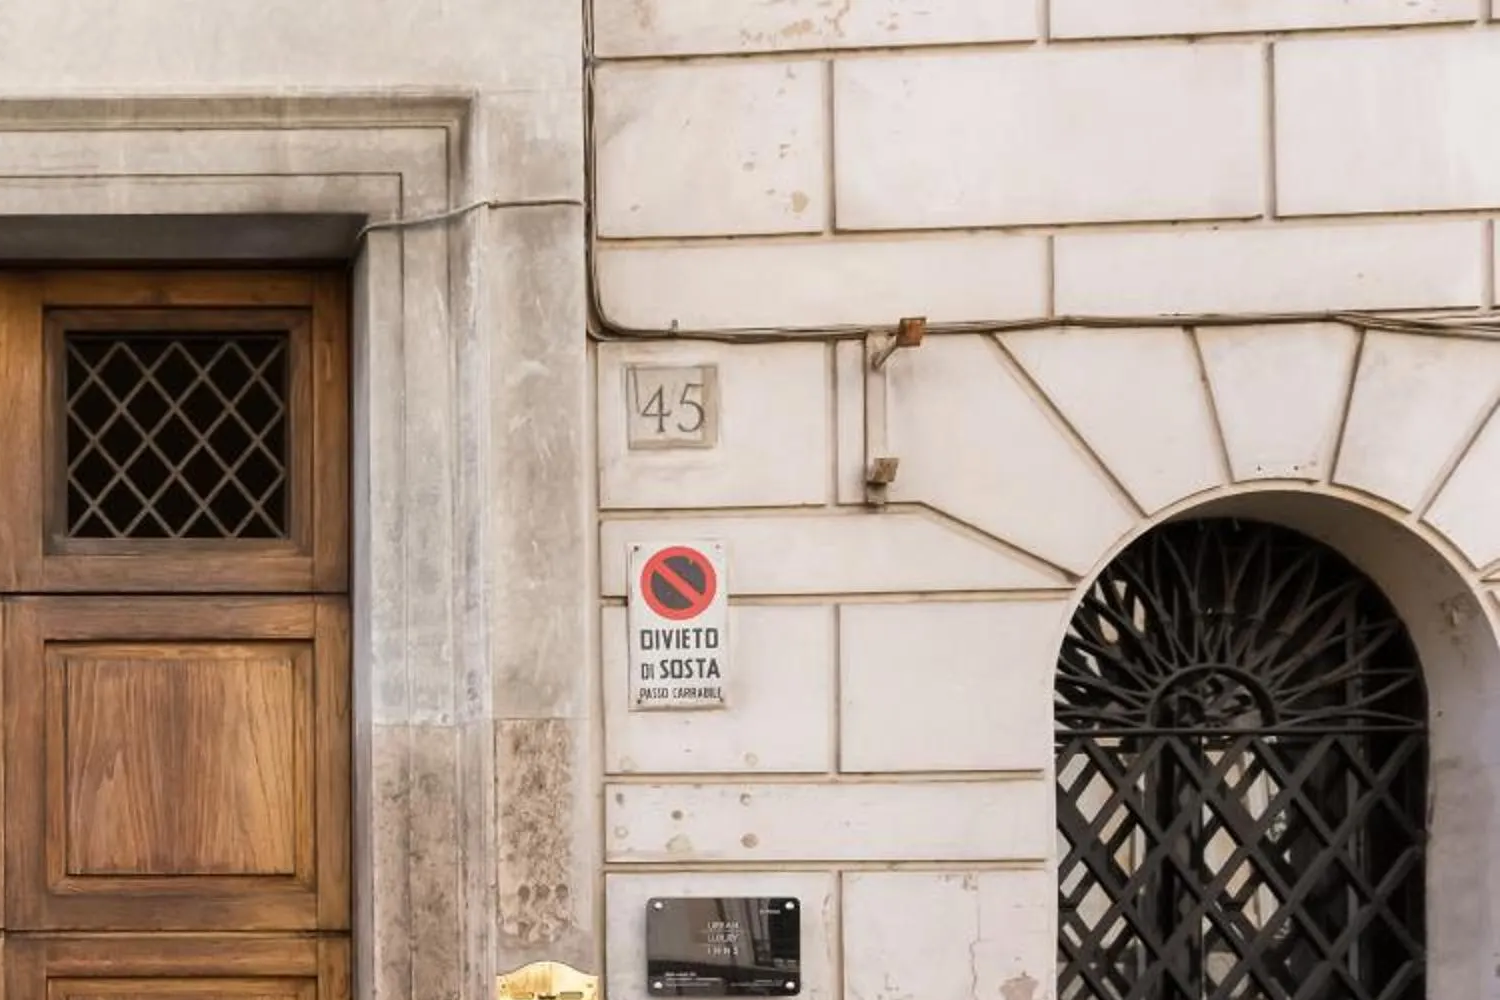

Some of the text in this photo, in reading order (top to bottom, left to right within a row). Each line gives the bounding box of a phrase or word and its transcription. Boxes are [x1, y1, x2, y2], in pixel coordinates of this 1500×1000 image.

[641, 383, 705, 433] 45
[640, 627, 719, 650] DIVIETO
[659, 658, 721, 679] SOSTA
[639, 686, 722, 699] PASSO CARRABILE
